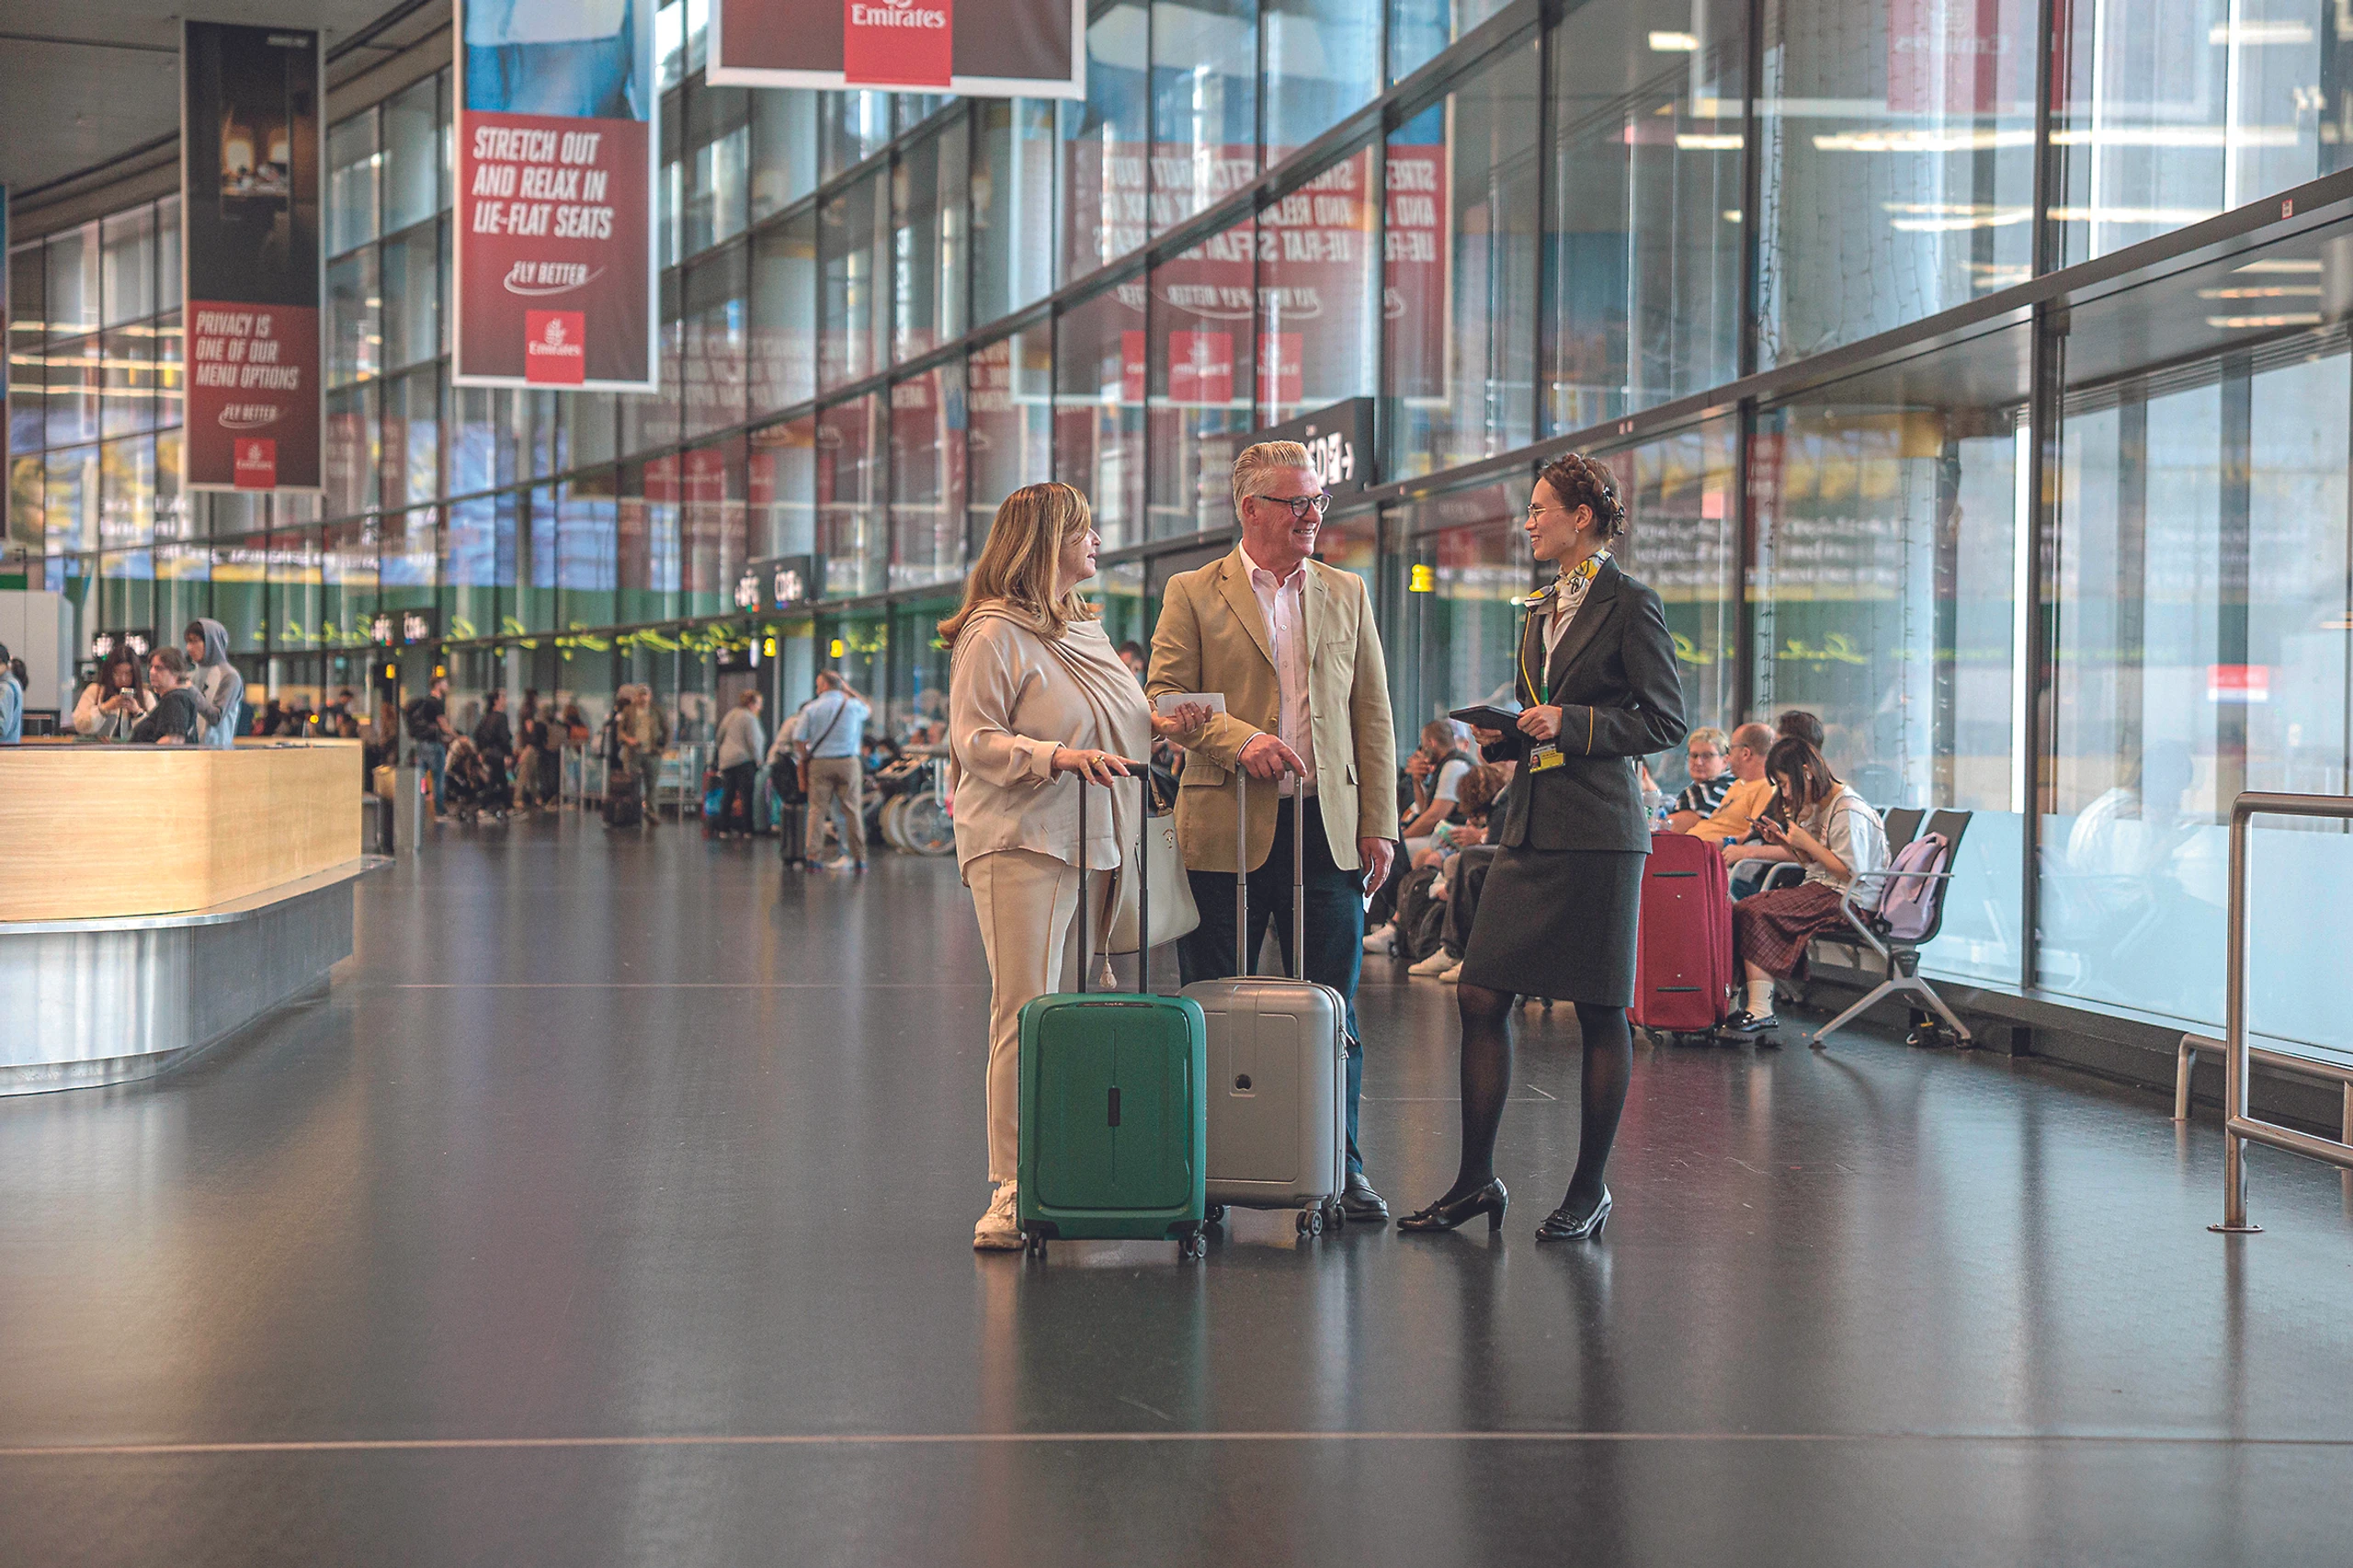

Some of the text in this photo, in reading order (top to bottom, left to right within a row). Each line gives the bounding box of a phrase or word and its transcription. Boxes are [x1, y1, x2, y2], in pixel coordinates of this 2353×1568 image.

[851, 4, 946, 28] Emirates
[472, 125, 601, 165] STRETCH OUT
[472, 163, 608, 202] AND RELAX IN
[472, 200, 615, 240] LIE-FLAT SEATS
[512, 260, 586, 285] FLY BETTER
[196, 311, 272, 338] PRIVACY IS
[195, 335, 278, 363] ONE OF OUR
[195, 361, 299, 390] MENU OPTIONS
